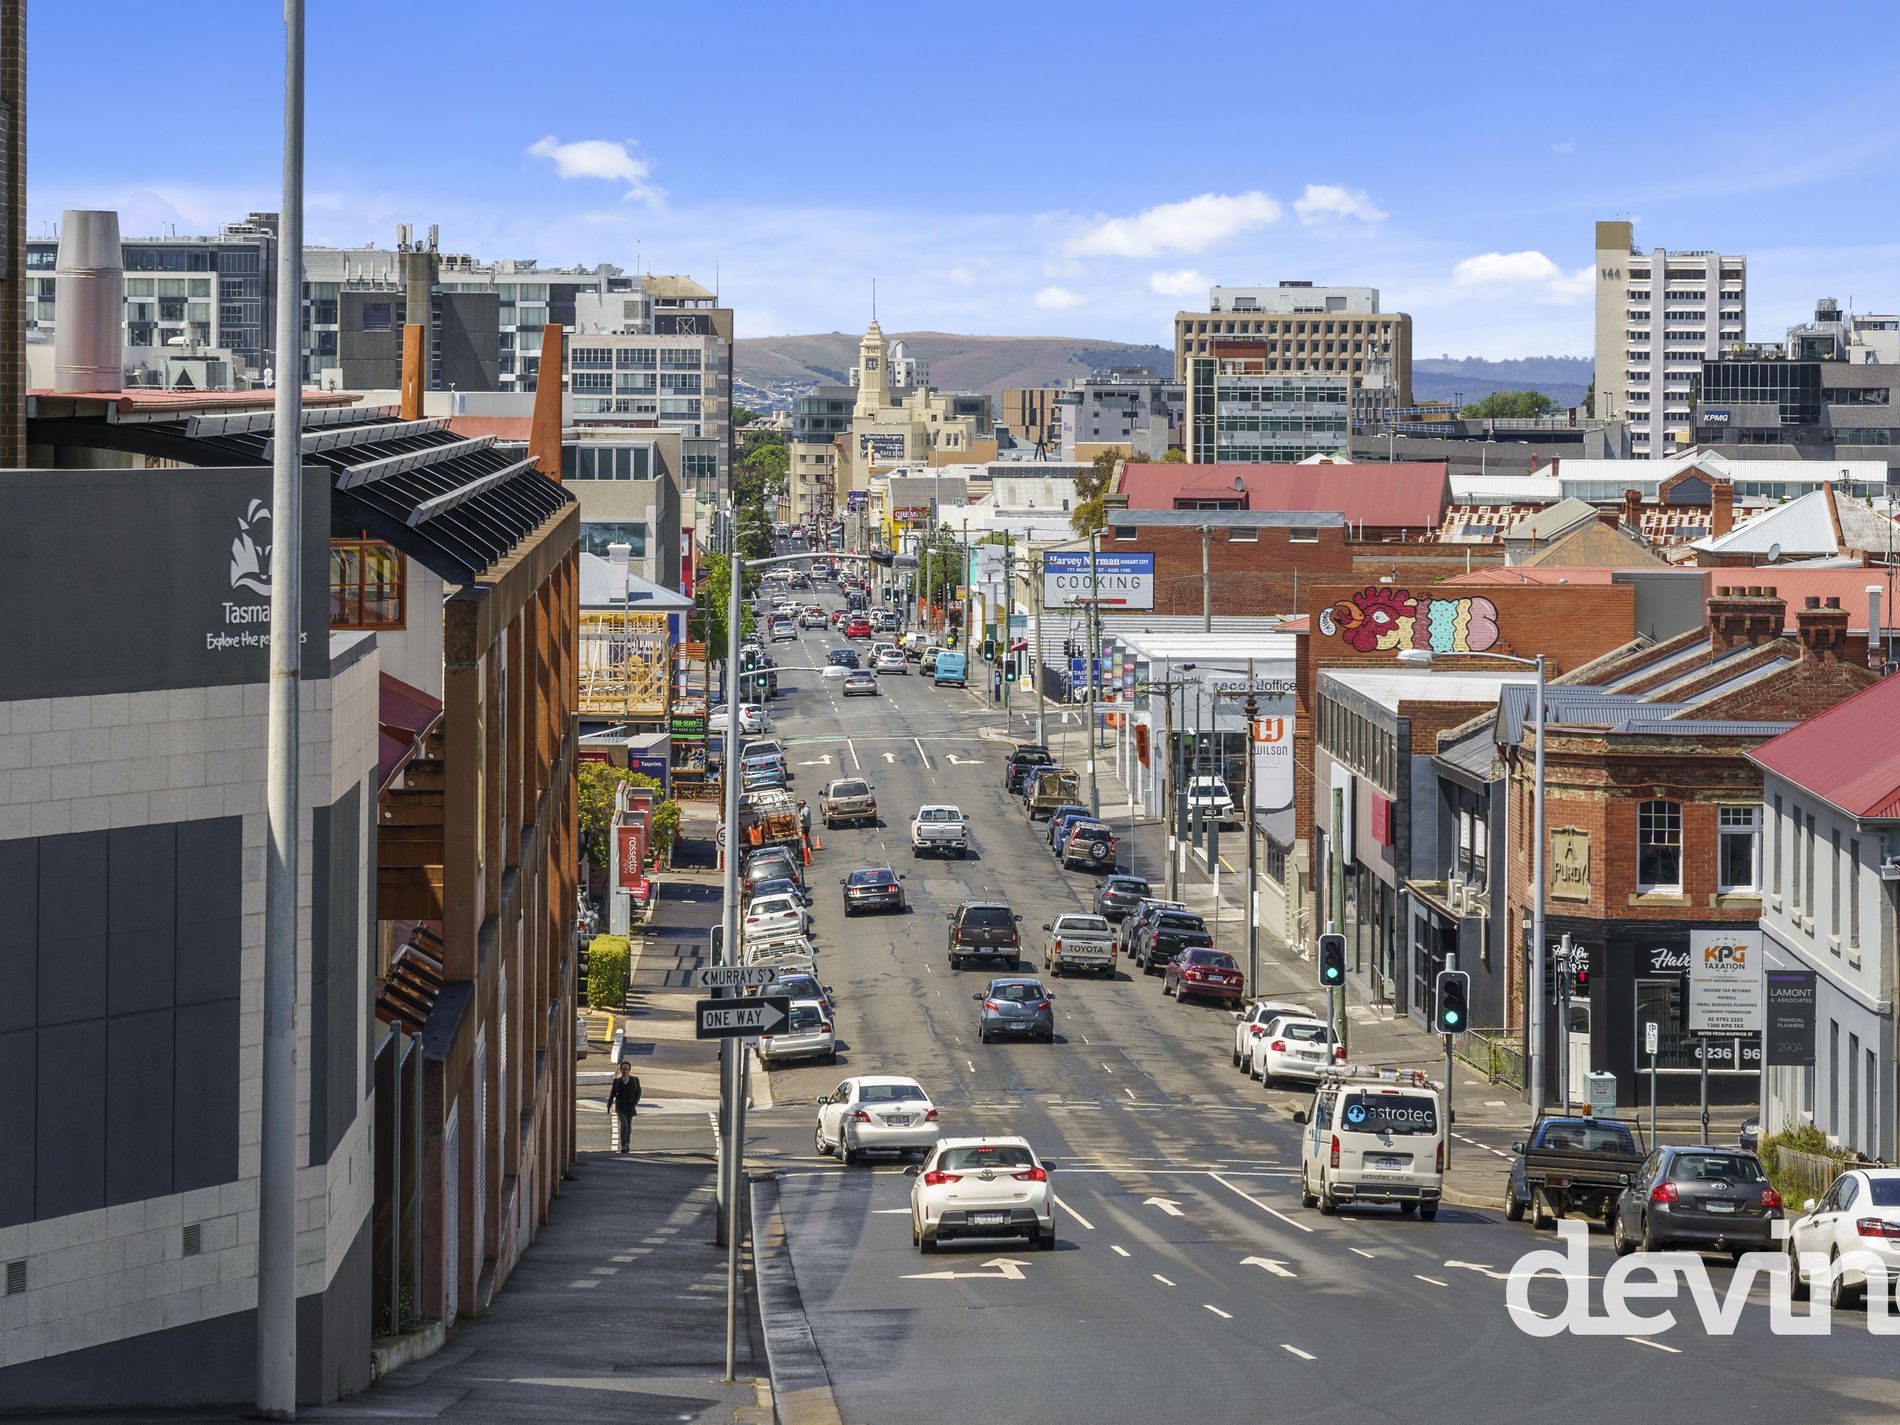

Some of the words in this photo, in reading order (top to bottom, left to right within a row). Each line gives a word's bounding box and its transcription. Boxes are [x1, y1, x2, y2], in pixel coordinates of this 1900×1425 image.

[1704, 414, 1729, 422] KPMG
[1049, 556, 1082, 566] Harvey
[1083, 557, 1120, 566] Nrman
[1057, 576, 1141, 589] COOKING
[206, 632, 240, 651] Explore
[240, 631, 259, 646] the
[1254, 745, 1288, 755] WILSON
[629, 836, 637, 874] rossetto
[1565, 840, 1577, 861] A
[1555, 863, 1587, 886] PURDY
[1069, 945, 1104, 953] TOYOTA
[1704, 946, 1748, 963] KPG
[710, 970, 753, 985] MURRAY
[1770, 989, 1812, 997] LAMONT
[706, 1011, 730, 1027] ONE
[736, 1009, 762, 1025] WAY
[1695, 1048, 1732, 1059] 6236
[1368, 1106, 1433, 1122] astrotec
[1361, 1174, 1415, 1182] astrotec.net.au
